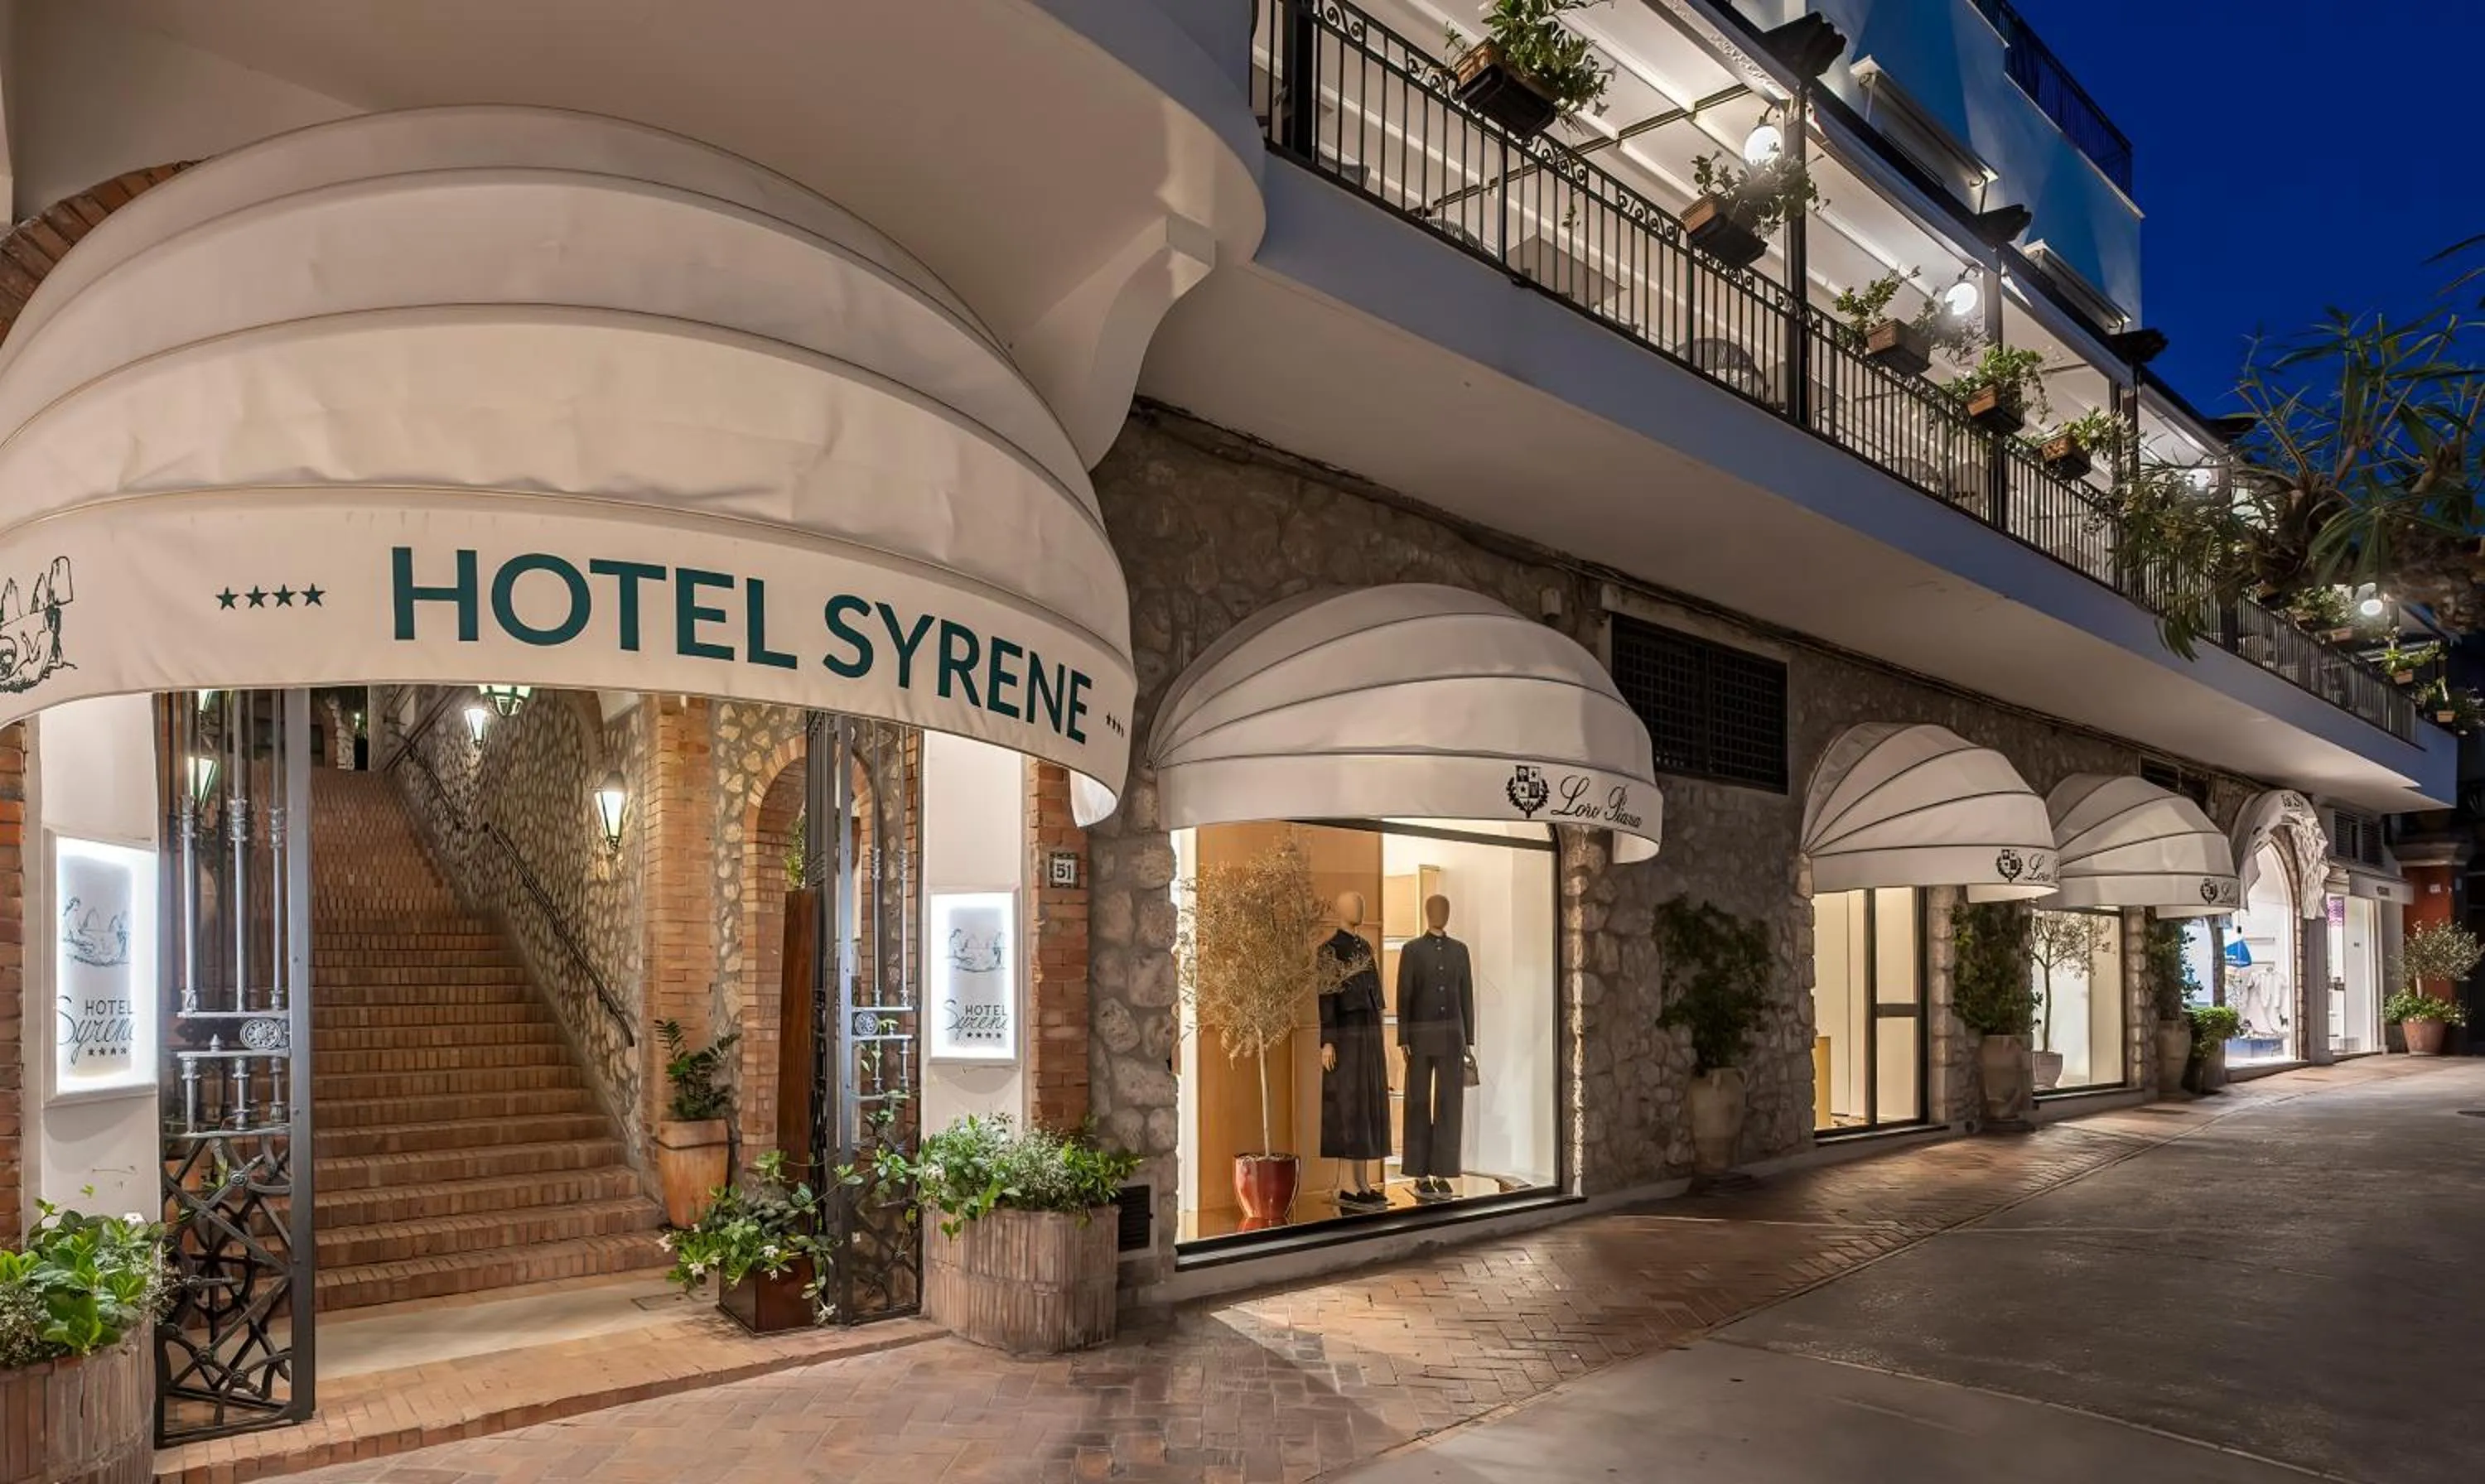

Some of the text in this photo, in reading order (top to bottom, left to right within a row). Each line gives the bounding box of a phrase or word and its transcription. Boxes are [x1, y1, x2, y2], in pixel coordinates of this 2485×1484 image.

[392, 547, 1093, 744] HOTEL SYRENE
[1550, 774, 1603, 818] Loro
[1056, 863, 1071, 880] 51
[84, 1000, 133, 1015] HOTEL
[965, 1005, 1008, 1015] HOTEL
